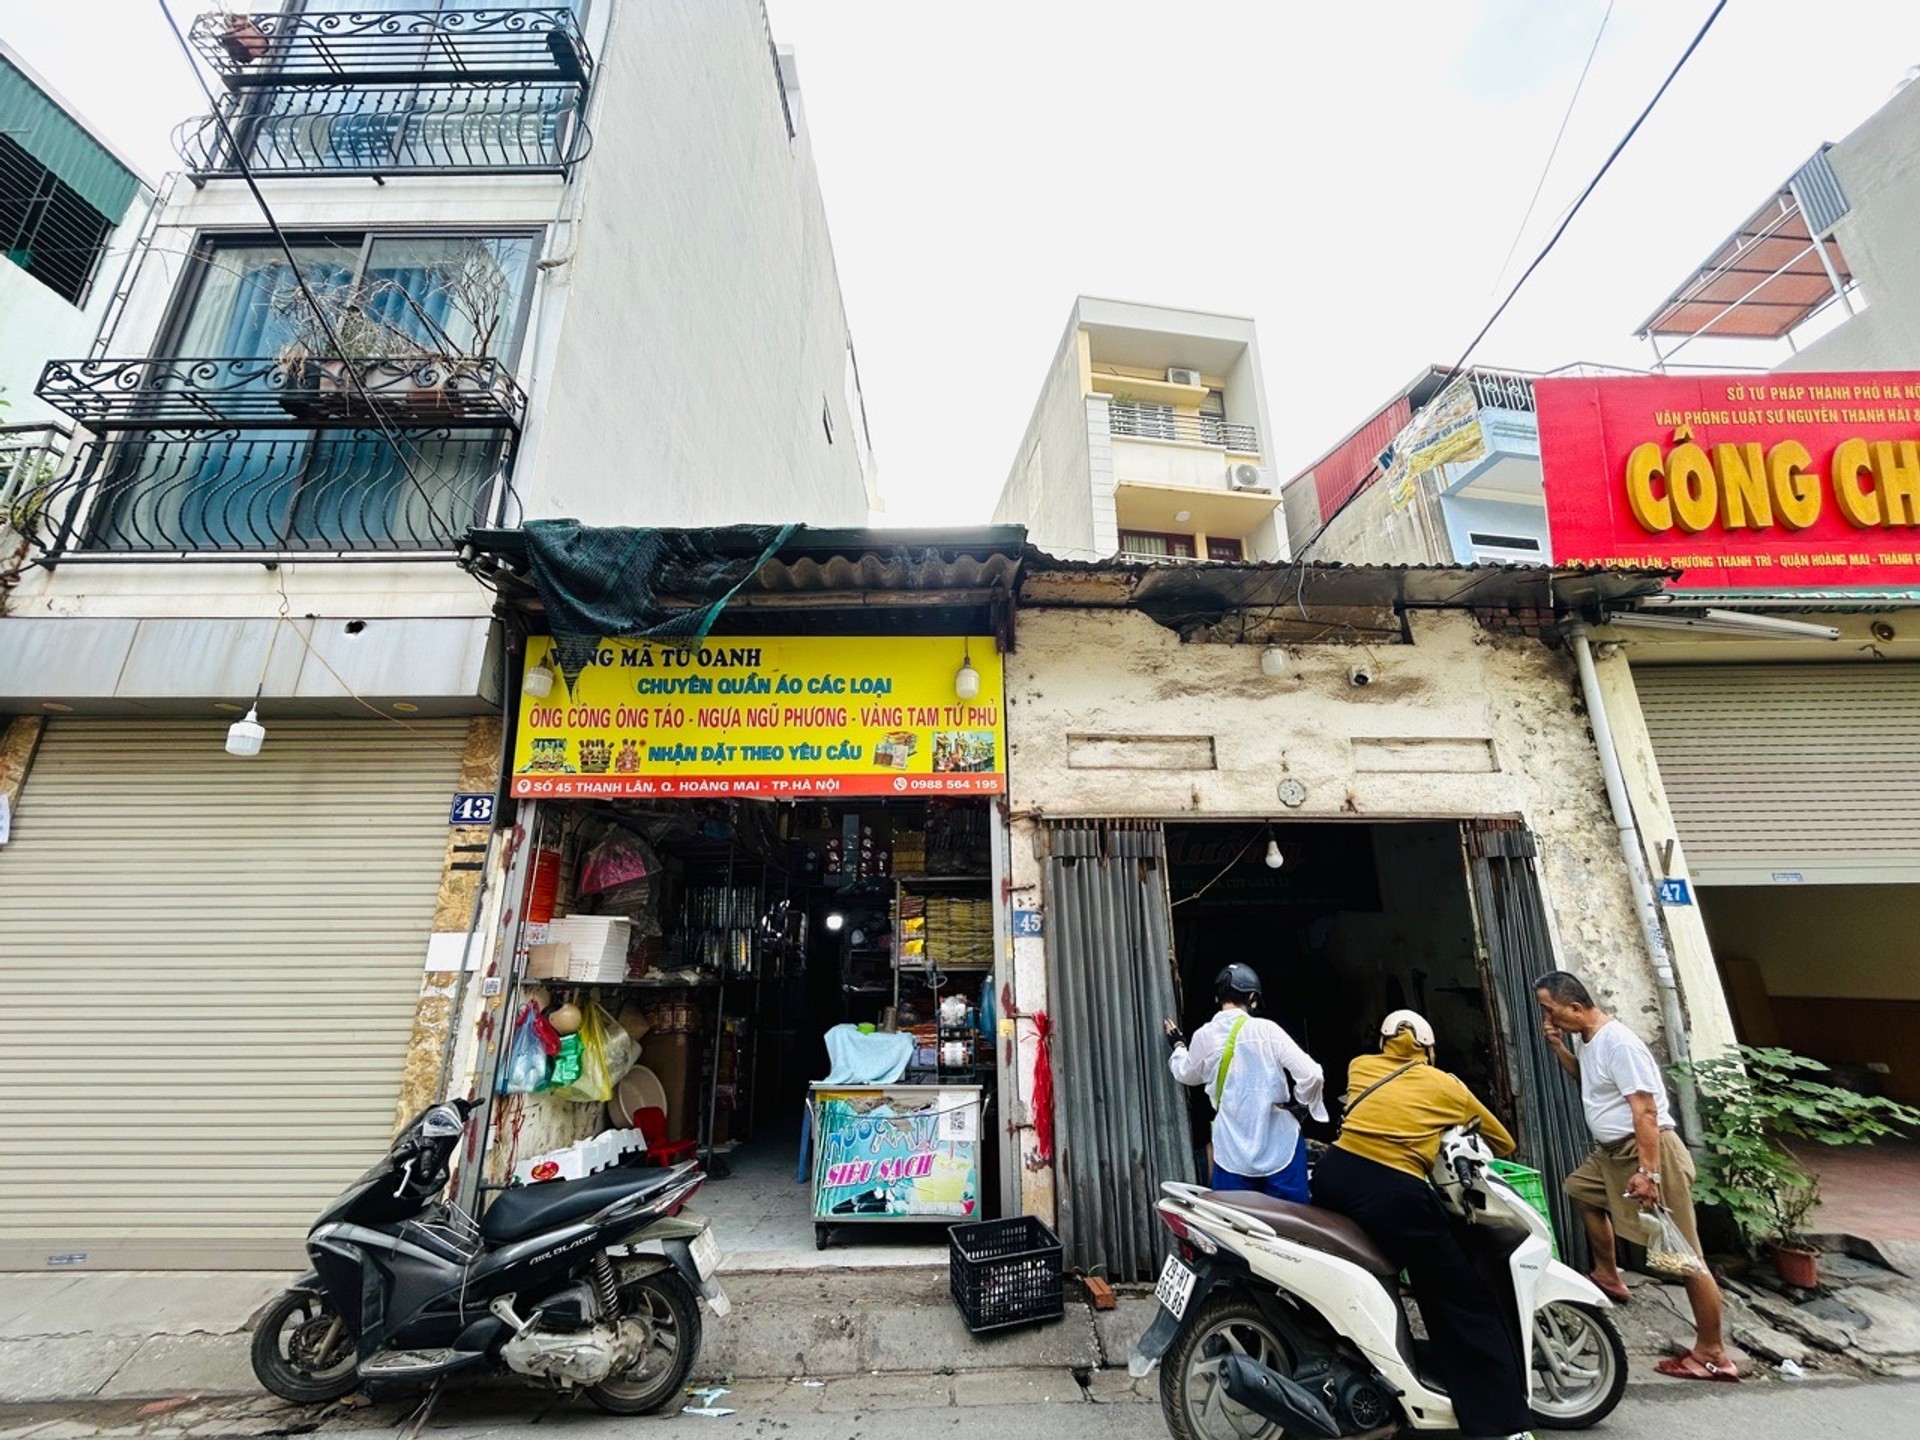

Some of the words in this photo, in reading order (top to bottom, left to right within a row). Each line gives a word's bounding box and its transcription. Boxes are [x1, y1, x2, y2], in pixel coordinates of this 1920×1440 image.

[1769, 384, 1805, 401] PHÁP
[1841, 408, 1886, 423] THANH
[1626, 424, 1822, 533] CÔNG
[1716, 556, 1752, 568] THANH
[1811, 553, 1846, 566] HOÀNG
[1848, 554, 1870, 566] MAI
[550, 648, 614, 667] VNG
[620, 644, 654, 667] MÃ
[697, 648, 762, 667] OANH
[637, 674, 712, 694] CHUYÊN
[775, 674, 804, 694] ÁO
[807, 674, 846, 694] CÁC
[850, 678, 893, 698] LOẠI
[529, 702, 562, 729] ÔNG
[567, 702, 611, 729] CÔNG
[616, 702, 649, 729] ÔNG
[653, 703, 685, 729] TÁO
[697, 707, 741, 734] NGỰA
[747, 703, 779, 728] NGŨ
[784, 707, 847, 728] PHƯƠNG
[861, 702, 903, 728] VÀNG
[907, 707, 939, 728] TAM
[944, 702, 964, 727] TỨ
[968, 698, 998, 727] PHỦ
[648, 742, 697, 766] NHẬN
[701, 742, 738, 766] ĐẶT
[740, 746, 783, 761] THEO
[788, 742, 822, 761] YÊU
[534, 778, 552, 792] SỐ
[555, 782, 571, 793] 45
[576, 782, 623, 793] THANH
[680, 779, 729, 792] HOÀNG
[733, 781, 760, 791] MAI
[816, 778, 840, 792] NỘI
[910, 780, 943, 790] 0988
[946, 780, 971, 790] 564
[975, 780, 998, 790] 195
[455, 798, 491, 819] 43
[1661, 883, 1681, 901] 47
[1020, 914, 1042, 932] 45
[879, 1152, 935, 1186] SẠCH
[553, 1231, 599, 1255] BLADE
